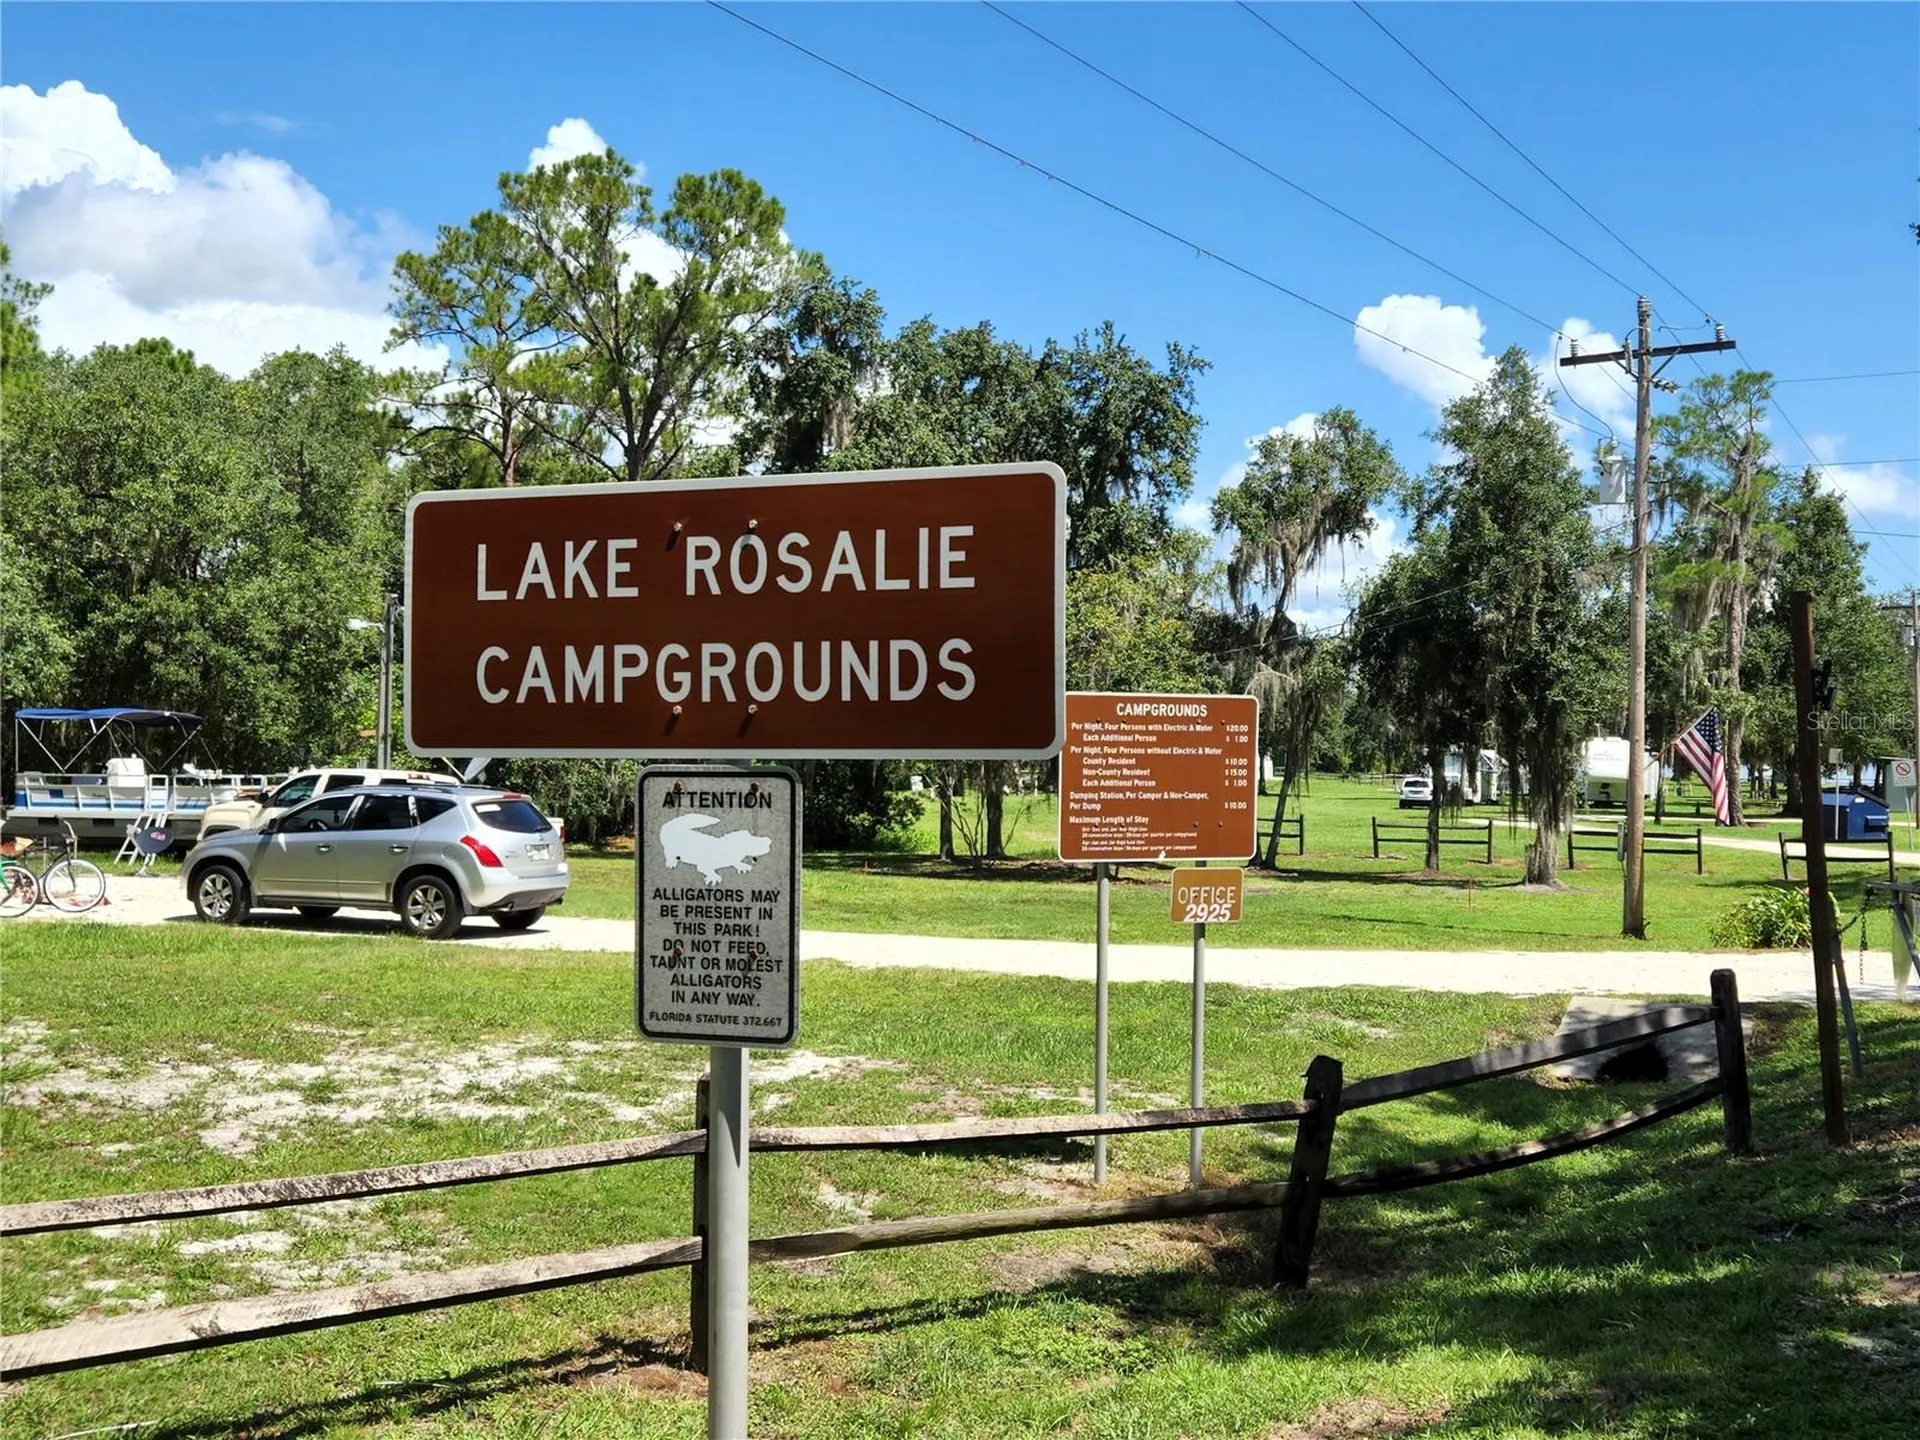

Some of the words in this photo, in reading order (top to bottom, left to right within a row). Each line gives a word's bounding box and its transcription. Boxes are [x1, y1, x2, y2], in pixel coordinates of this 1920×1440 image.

[477, 538, 639, 601] LAKE
[686, 525, 976, 596] ROSALIE
[477, 638, 976, 703] CAMPGROUNDS
[1116, 703, 1208, 717] CAMPGROUNDS
[1071, 722, 1083, 730] Per
[1105, 723, 1119, 731] Four
[1120, 723, 1146, 731] Persons
[1148, 723, 1163, 731] with
[1163, 723, 1188, 732] Electric
[1195, 724, 1213, 732] Water
[1226, 725, 1249, 733] $20.00
[1083, 733, 1099, 741] Each
[1100, 733, 1134, 742] Additional
[1134, 734, 1157, 742] Person
[1070, 745, 1082, 754] Per
[1103, 746, 1118, 754] Four
[1119, 746, 1145, 754] Persons
[1147, 746, 1172, 755] without
[1173, 747, 1197, 755] Electric
[1204, 747, 1222, 755] Water
[1083, 757, 1107, 767] County
[1108, 757, 1136, 765] Resident
[1082, 768, 1121, 777] Non-County
[1122, 768, 1151, 776] Resident
[1082, 779, 1099, 787] Each
[1100, 779, 1133, 787] Additional
[1133, 779, 1156, 787] Person
[662, 792, 772, 809] ATTENTION
[1069, 791, 1099, 801] Dumping
[1126, 791, 1137, 799] Per
[1138, 791, 1162, 801] Camper
[1069, 802, 1081, 810] Per
[1082, 802, 1101, 811] Dump
[1069, 816, 1101, 824] Maximum
[1102, 816, 1125, 825] Length
[1134, 816, 1149, 824] Stay
[653, 888, 744, 902] ALLIGATORS
[751, 890, 780, 903] MAY
[1178, 886, 1237, 904] OFFICE
[660, 905, 678, 918] BE
[685, 905, 752, 919] PRESENT
[759, 908, 773, 920] IN
[1184, 903, 1232, 922] 2925
[673, 922, 706, 935] THIS
[663, 939, 684, 952] DO
[691, 940, 721, 953] NOT
[728, 941, 769, 957] FEED,
[650, 955, 695, 969] TAUNT
[701, 957, 720, 970] OR
[726, 958, 783, 973] MOLEST
[670, 973, 762, 989] ALLIGATORS
[671, 990, 685, 1003] IN
[691, 991, 721, 1005] ANY
[726, 993, 760, 1007] WAY.
[650, 1011, 692, 1022] FLORIDA
[696, 1013, 740, 1025] STATUTE
[743, 1015, 783, 1027] 372.667
